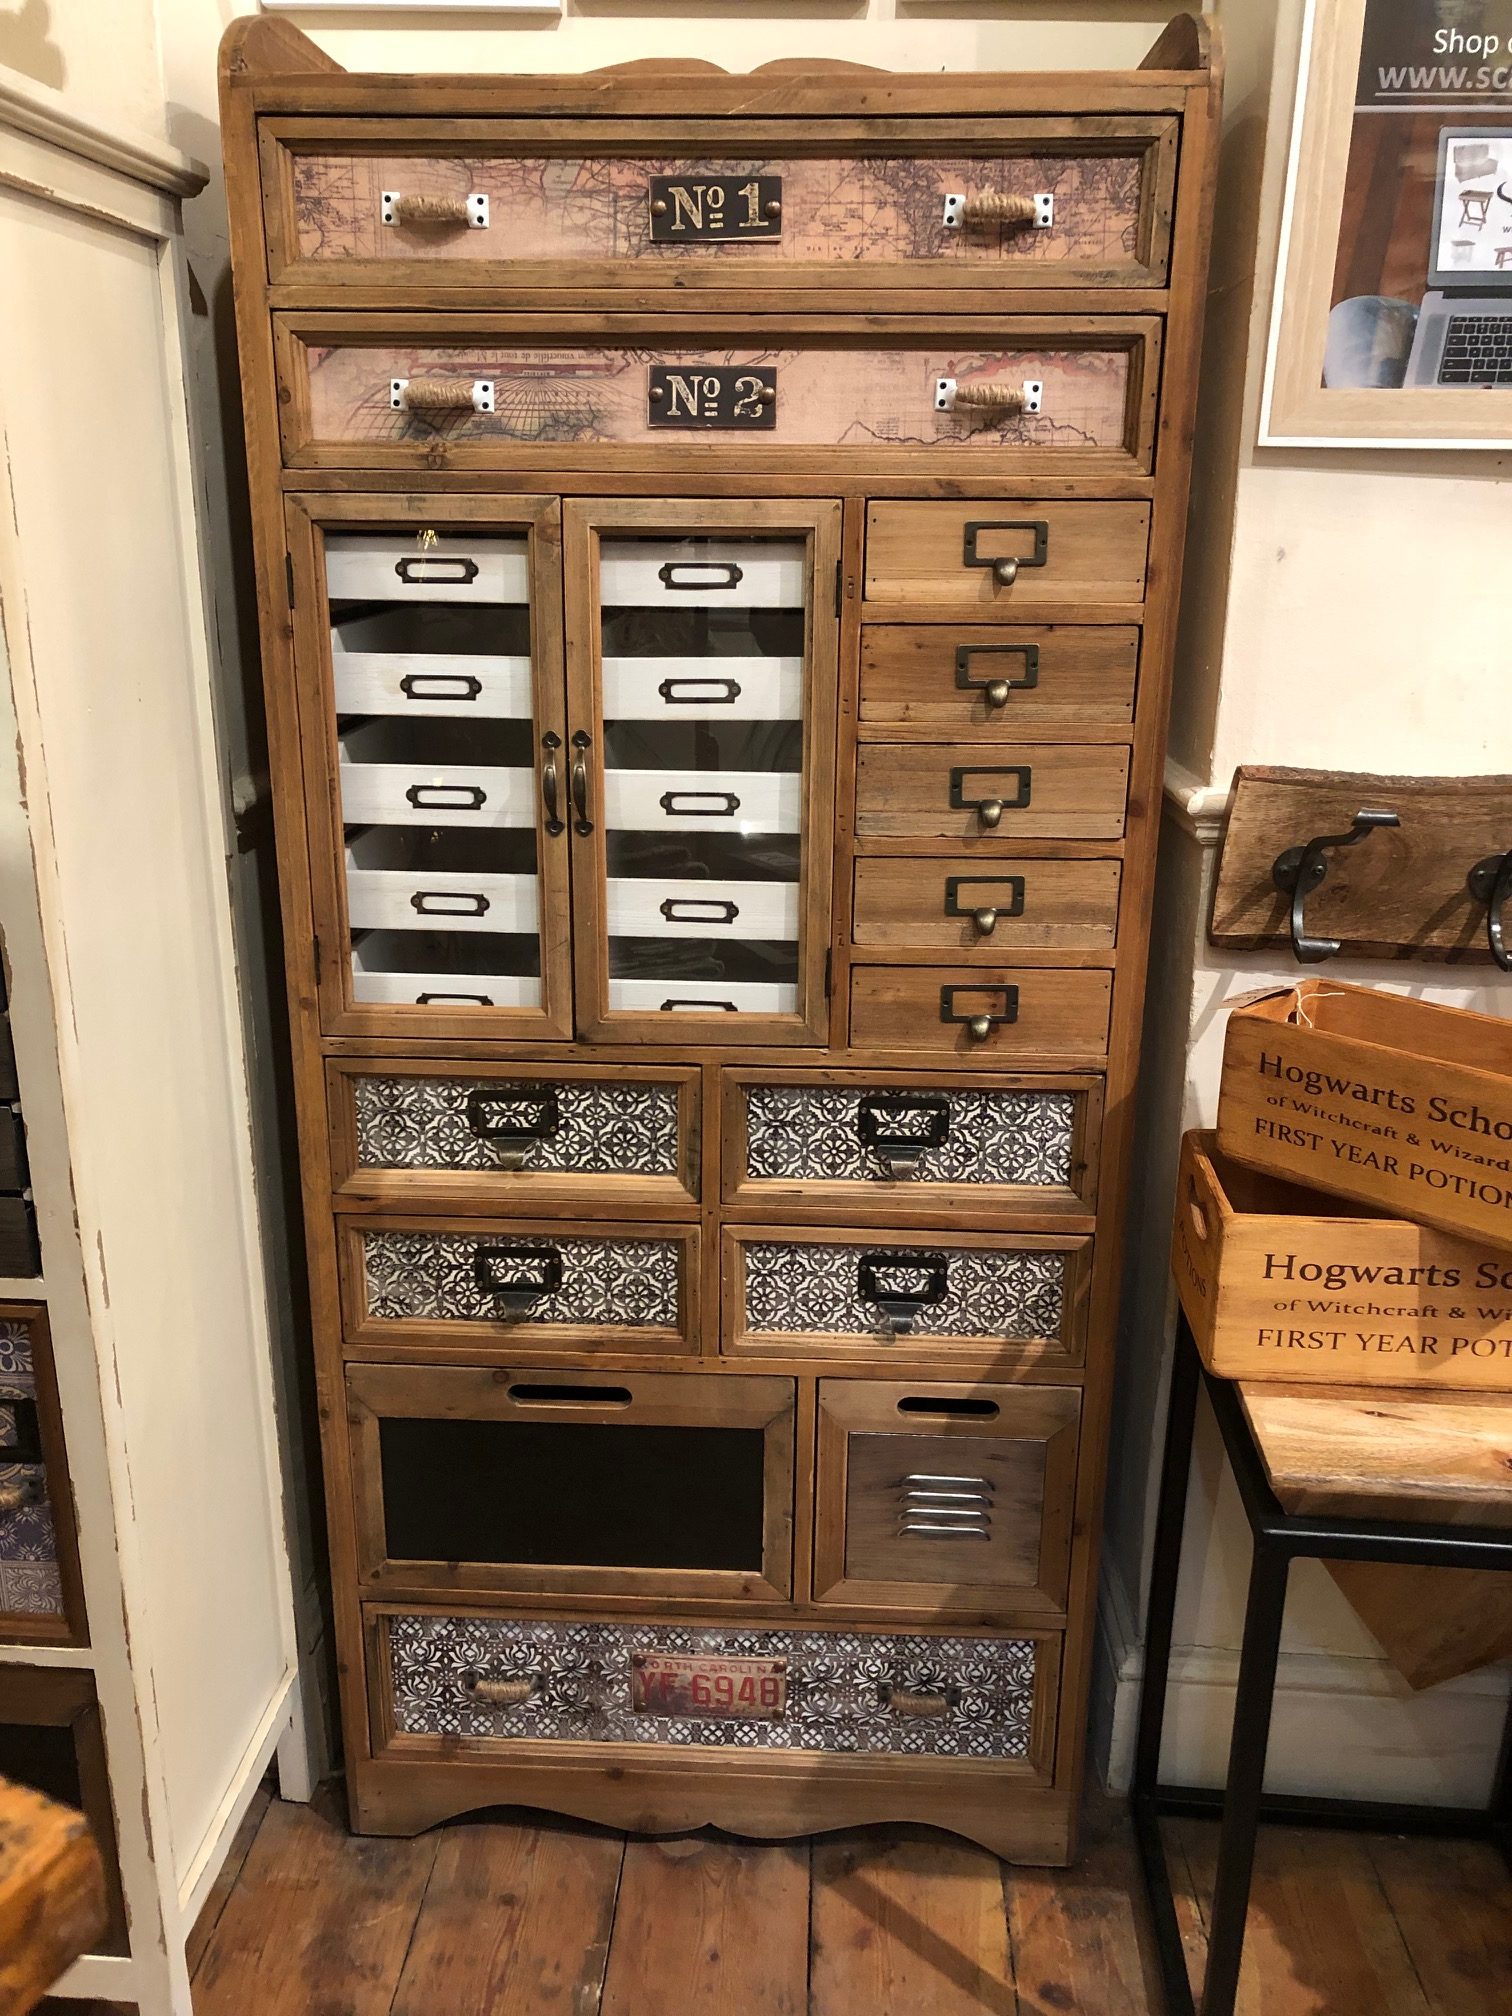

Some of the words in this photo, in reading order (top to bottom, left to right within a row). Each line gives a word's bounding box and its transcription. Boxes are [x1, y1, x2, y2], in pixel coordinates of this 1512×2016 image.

[1433, 28, 1499, 59] Shop
[738, 182, 769, 227] 1
[733, 376, 764, 418] 2
[1259, 1052, 1415, 1114] Hogwarts
[1427, 1097, 1512, 1140] Scho
[1266, 1096, 1288, 1107] of
[1292, 1100, 1398, 1140] Witchcraft
[1406, 1132, 1420, 1146] &
[1255, 1117, 1323, 1151] FIRST
[1330, 1139, 1399, 1176] YEAR
[1262, 1253, 1461, 1290] Hogwarts
[1273, 1299, 1302, 1311] of
[1307, 1300, 1439, 1318] Witchcraft
[1448, 1306, 1466, 1319] &
[1256, 1328, 1347, 1350] FIRST
[1356, 1333, 1438, 1355] YEAR
[642, 1660, 693, 1671] ORTH
[692, 1674, 780, 1707] 6948
